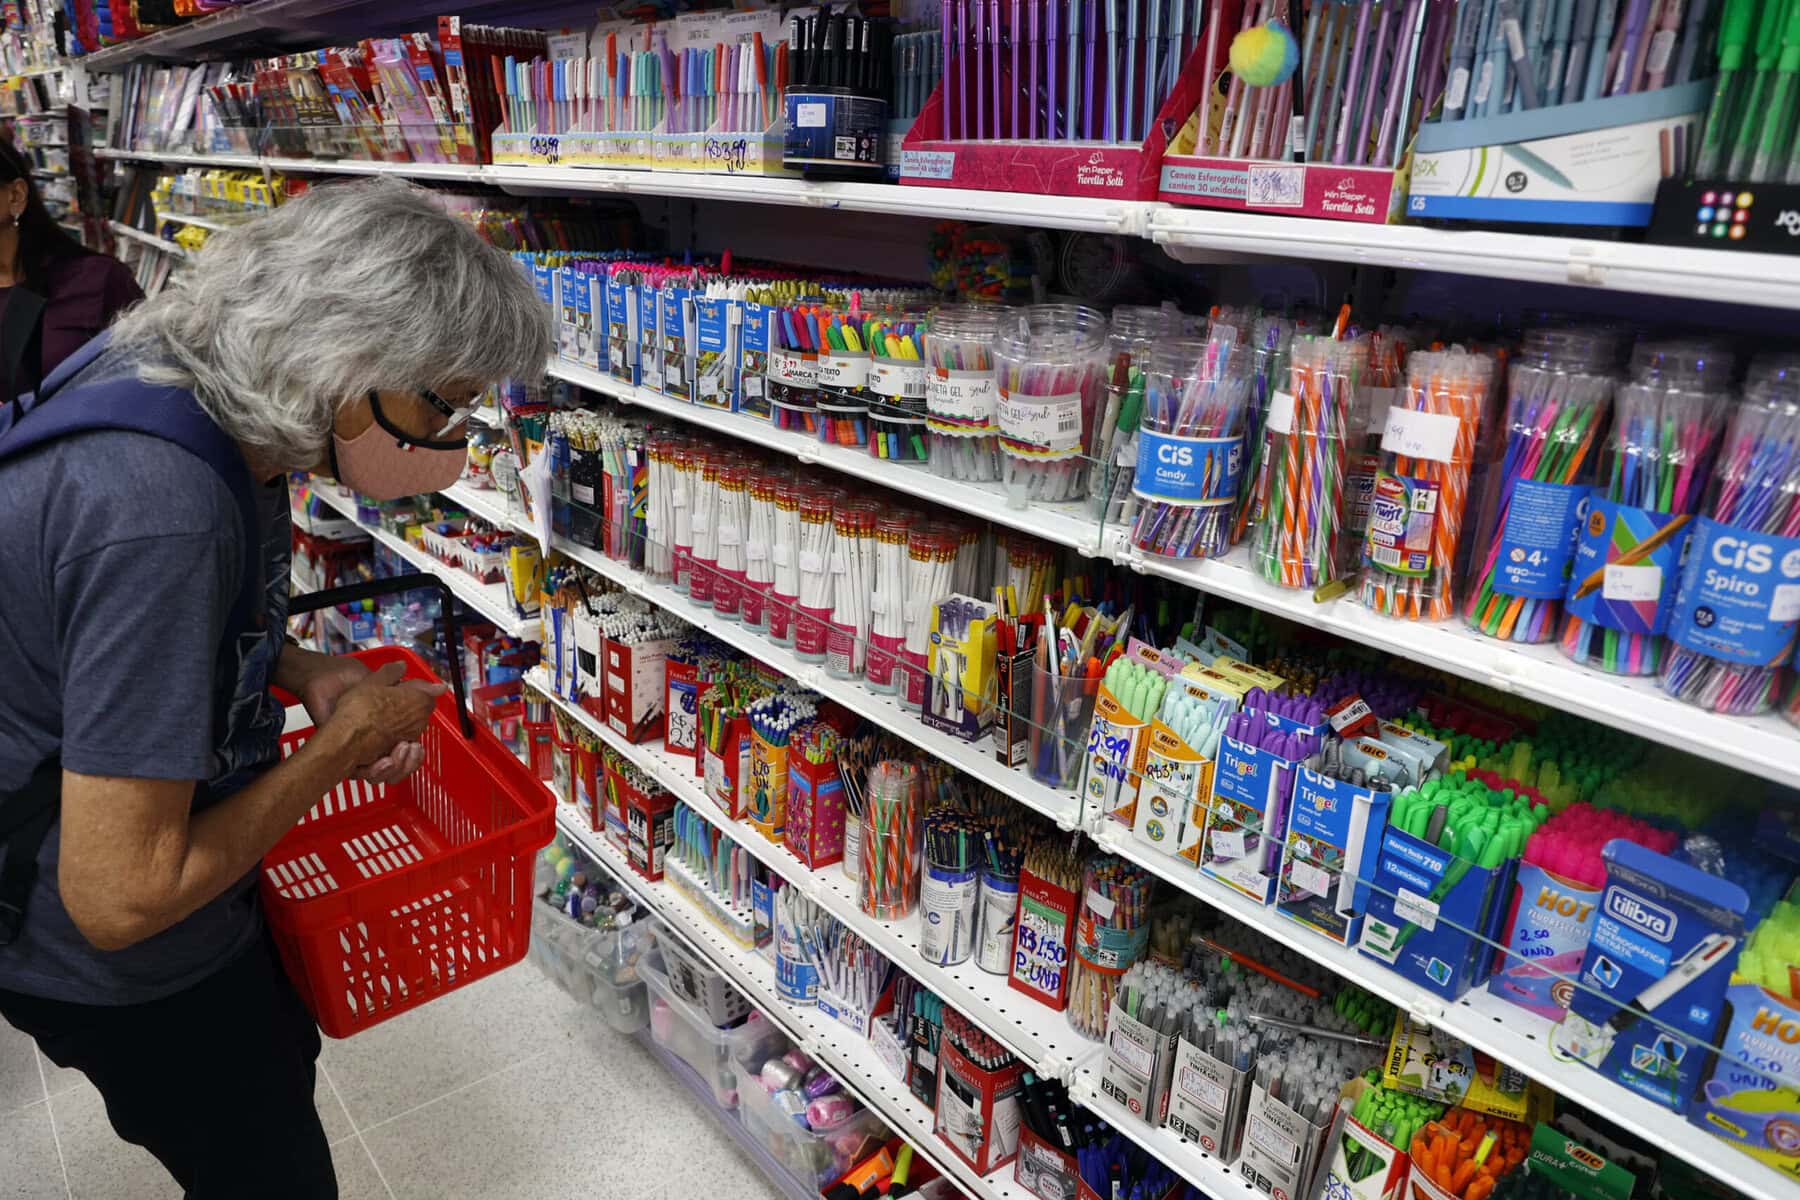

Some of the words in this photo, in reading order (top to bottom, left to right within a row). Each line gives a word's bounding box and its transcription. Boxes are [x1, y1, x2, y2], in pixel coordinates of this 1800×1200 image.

[1169, 169, 1196, 180] Caneta
[1158, 443, 1193, 466] CiS
[1156, 466, 1187, 483] Candy
[1712, 535, 1773, 574] CiS
[1704, 568, 1760, 597] Spiro
[1159, 733, 1178, 746] BIC
[1360, 743, 1386, 759] BIC
[1224, 752, 1258, 777] Trigel
[1301, 786, 1338, 813] Trigel
[1423, 856, 1442, 872] 710
[1536, 885, 1597, 923] HOT
[1612, 894, 1667, 934] tilibra
[1751, 1005, 1800, 1045] HO
